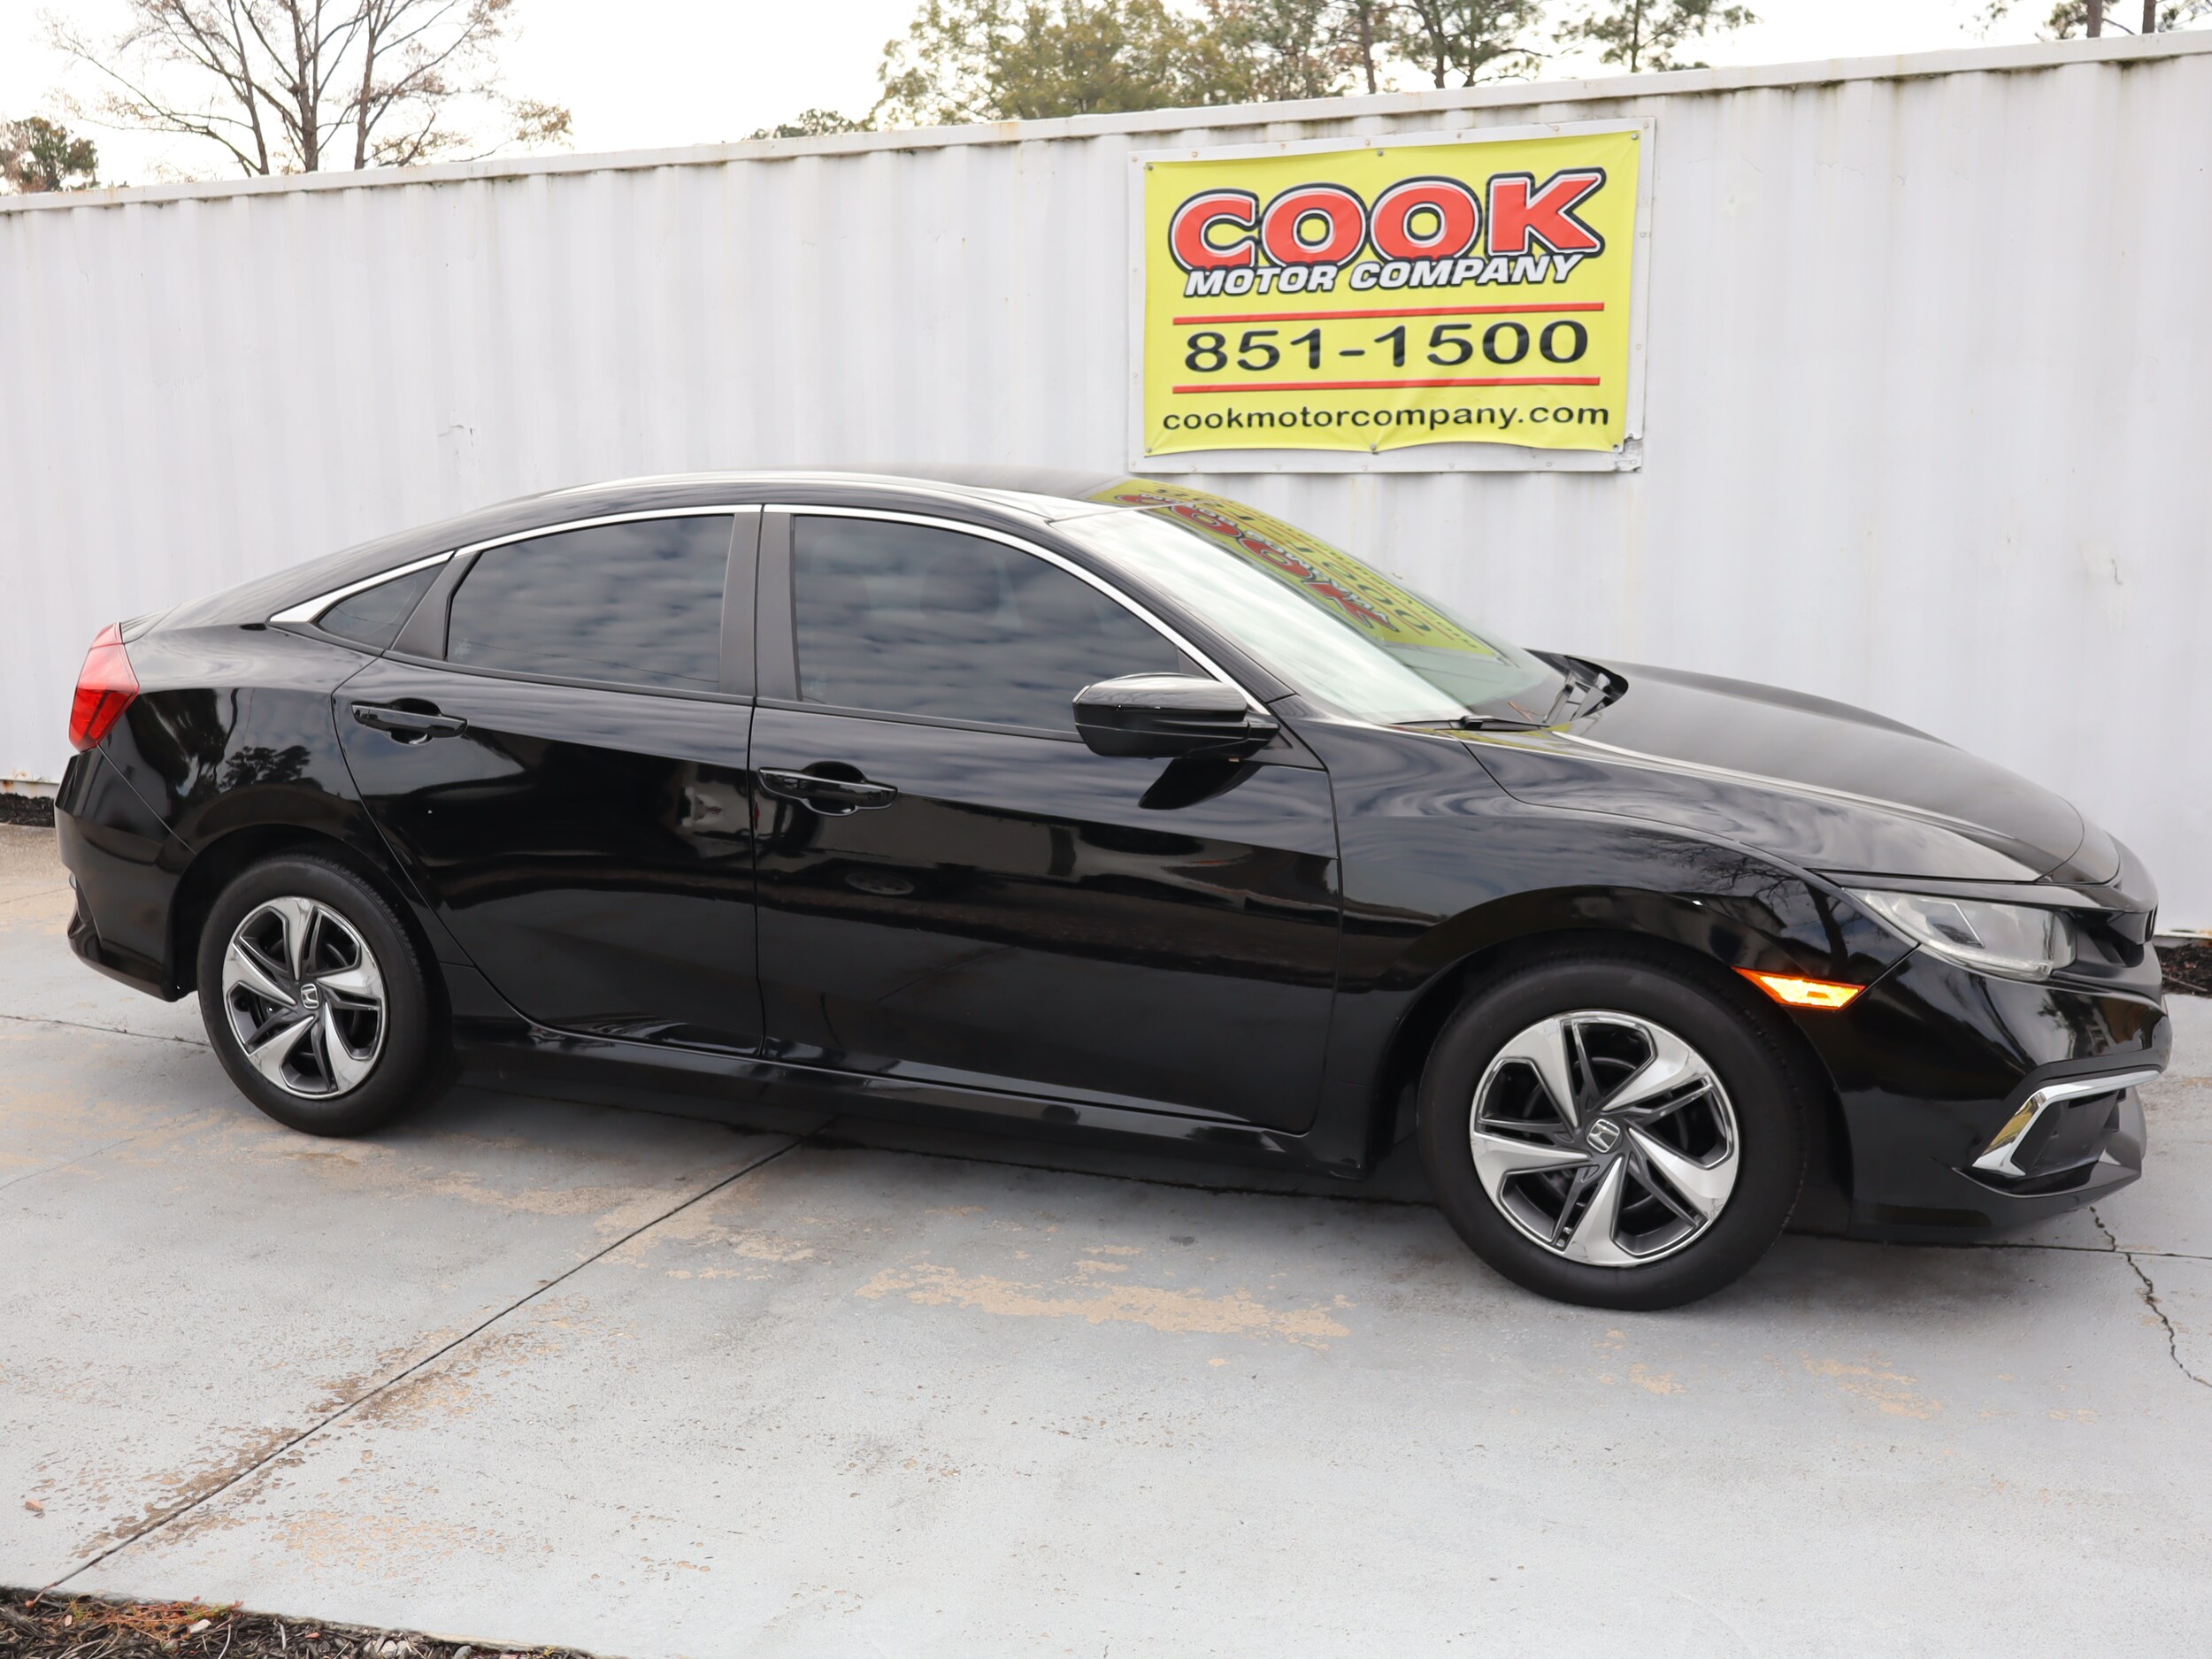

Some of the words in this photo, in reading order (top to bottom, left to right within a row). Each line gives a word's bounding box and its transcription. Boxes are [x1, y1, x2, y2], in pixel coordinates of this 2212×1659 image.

[1169, 169, 1606, 272] COOK
[1183, 263, 1338, 297] MOTOR
[1349, 255, 1583, 290] COMPANY
[1185, 321, 1588, 373] 851-1500
[1163, 404, 1609, 431] cookmotorcompany.com
